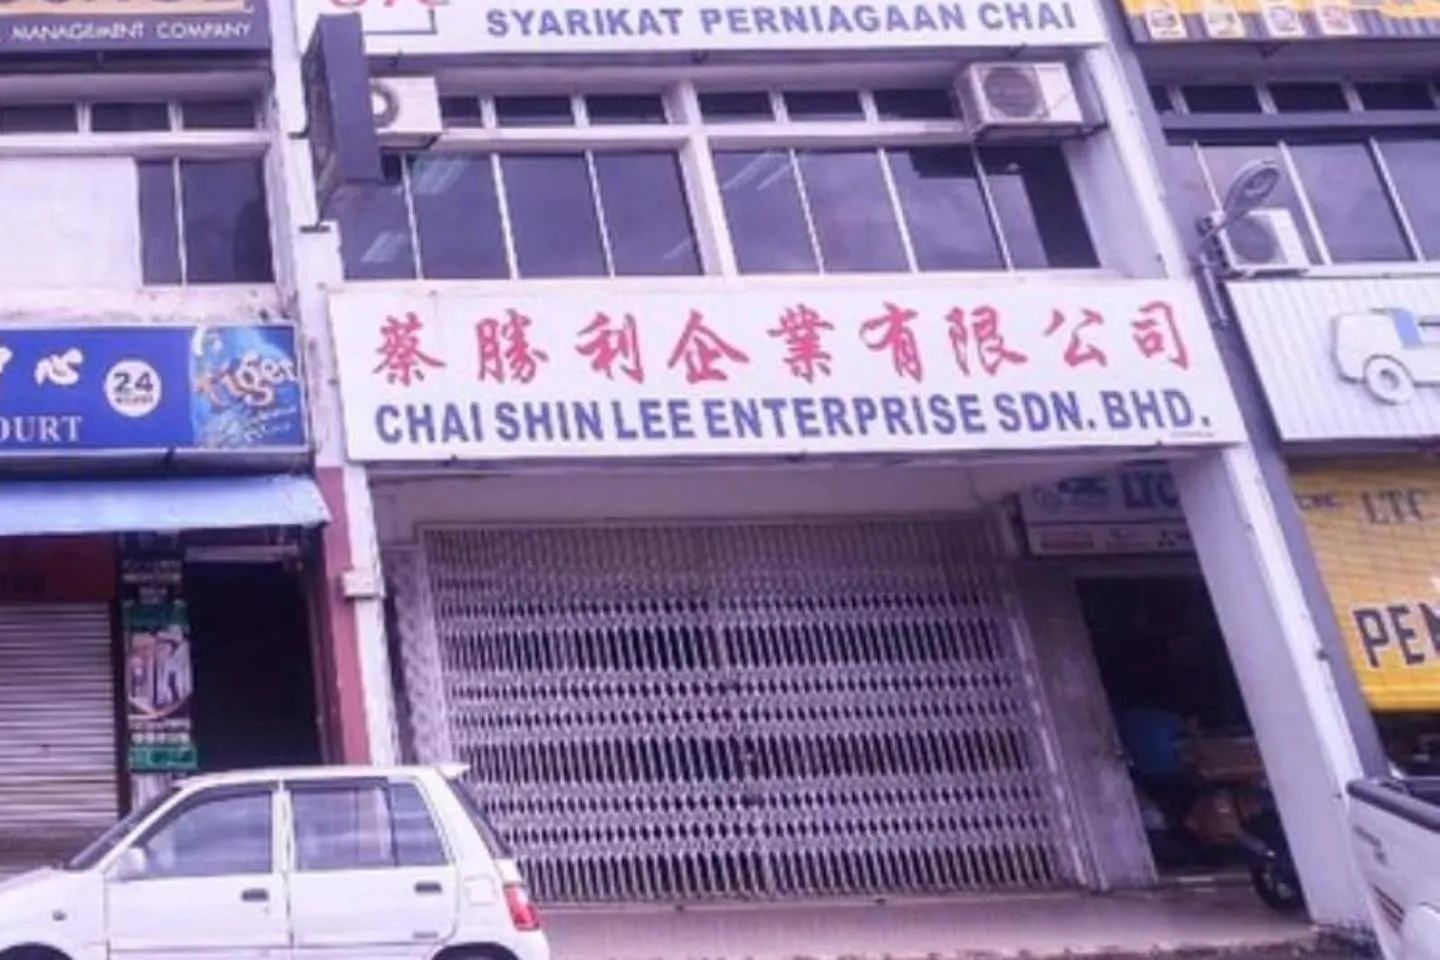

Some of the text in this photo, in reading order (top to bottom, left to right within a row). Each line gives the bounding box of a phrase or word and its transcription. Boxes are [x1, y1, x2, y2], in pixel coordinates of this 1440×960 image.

[157, 21, 251, 40] COMPANY
[486, 1, 1077, 39] SYARIKAT PERNIAGAAN CHAI
[371, 299, 1193, 385] 蔡勝利企業有限公司
[113, 371, 154, 392] 24
[197, 351, 298, 409] Tiger
[375, 387, 1211, 444] CHAI SHIN LEE ENTERPRISE SDN. BHD.
